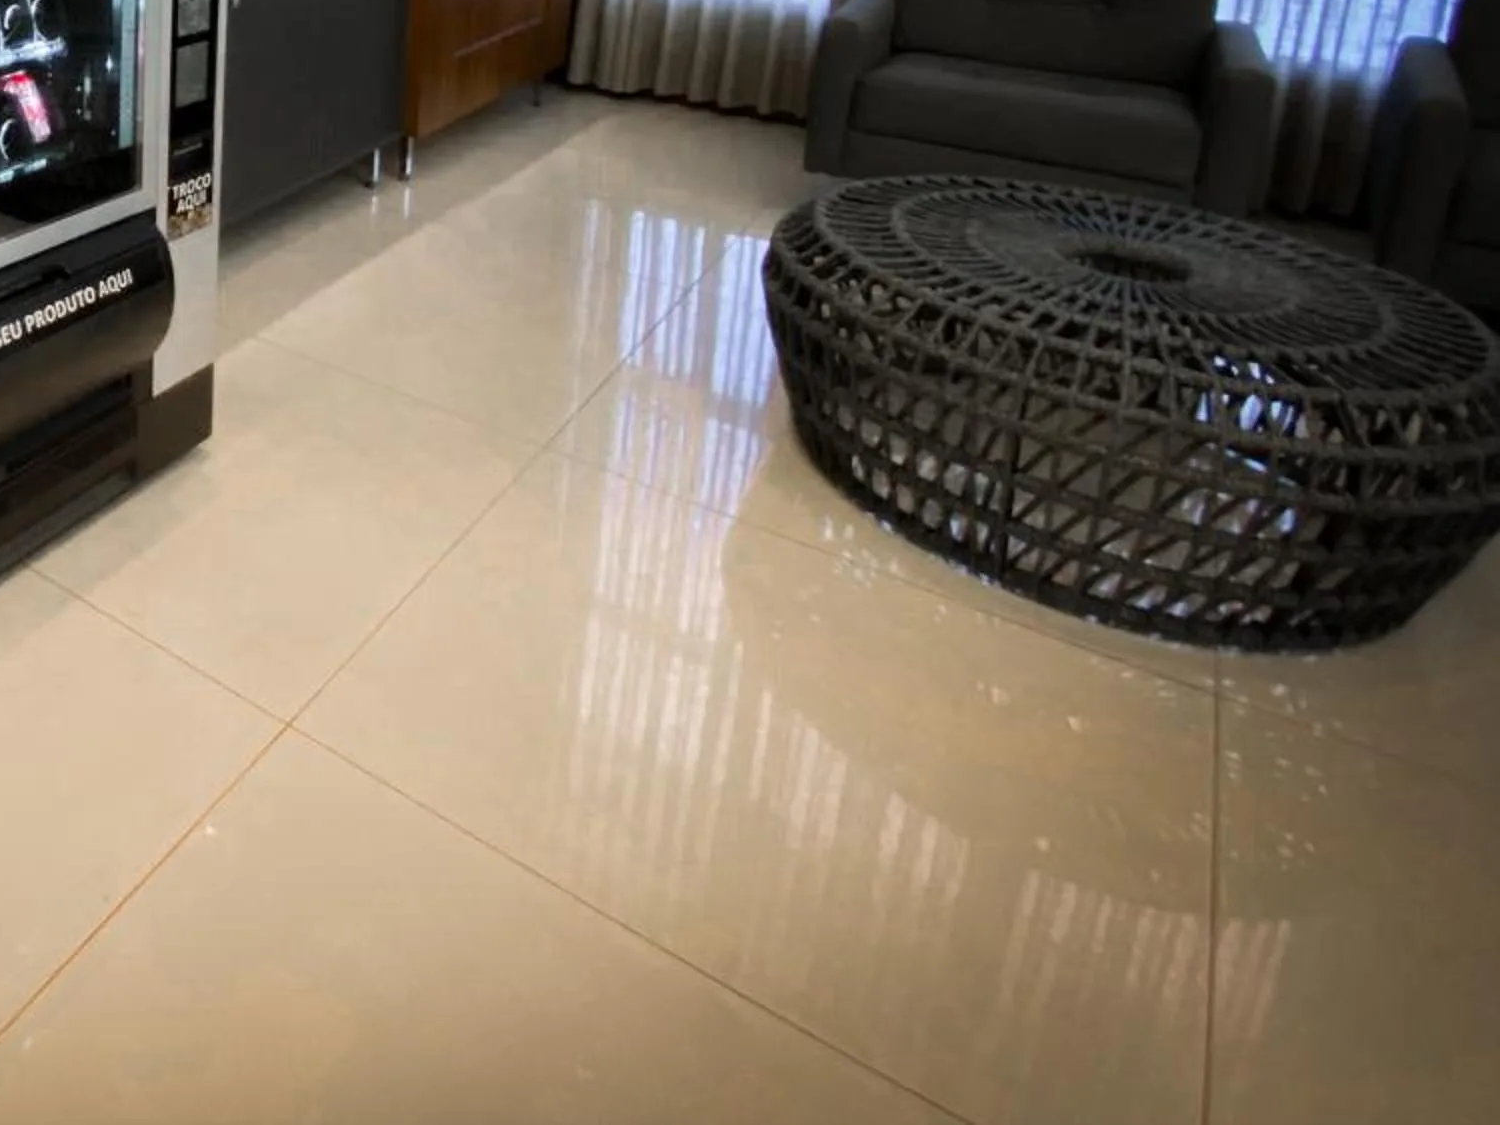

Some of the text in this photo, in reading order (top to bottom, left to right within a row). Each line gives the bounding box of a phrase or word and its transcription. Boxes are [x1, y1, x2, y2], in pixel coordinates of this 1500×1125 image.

[173, 172, 211, 201] TROCO
[176, 189, 208, 214] AQUI
[24, 285, 97, 334] PRODUTO
[98, 267, 134, 298] AQUI
